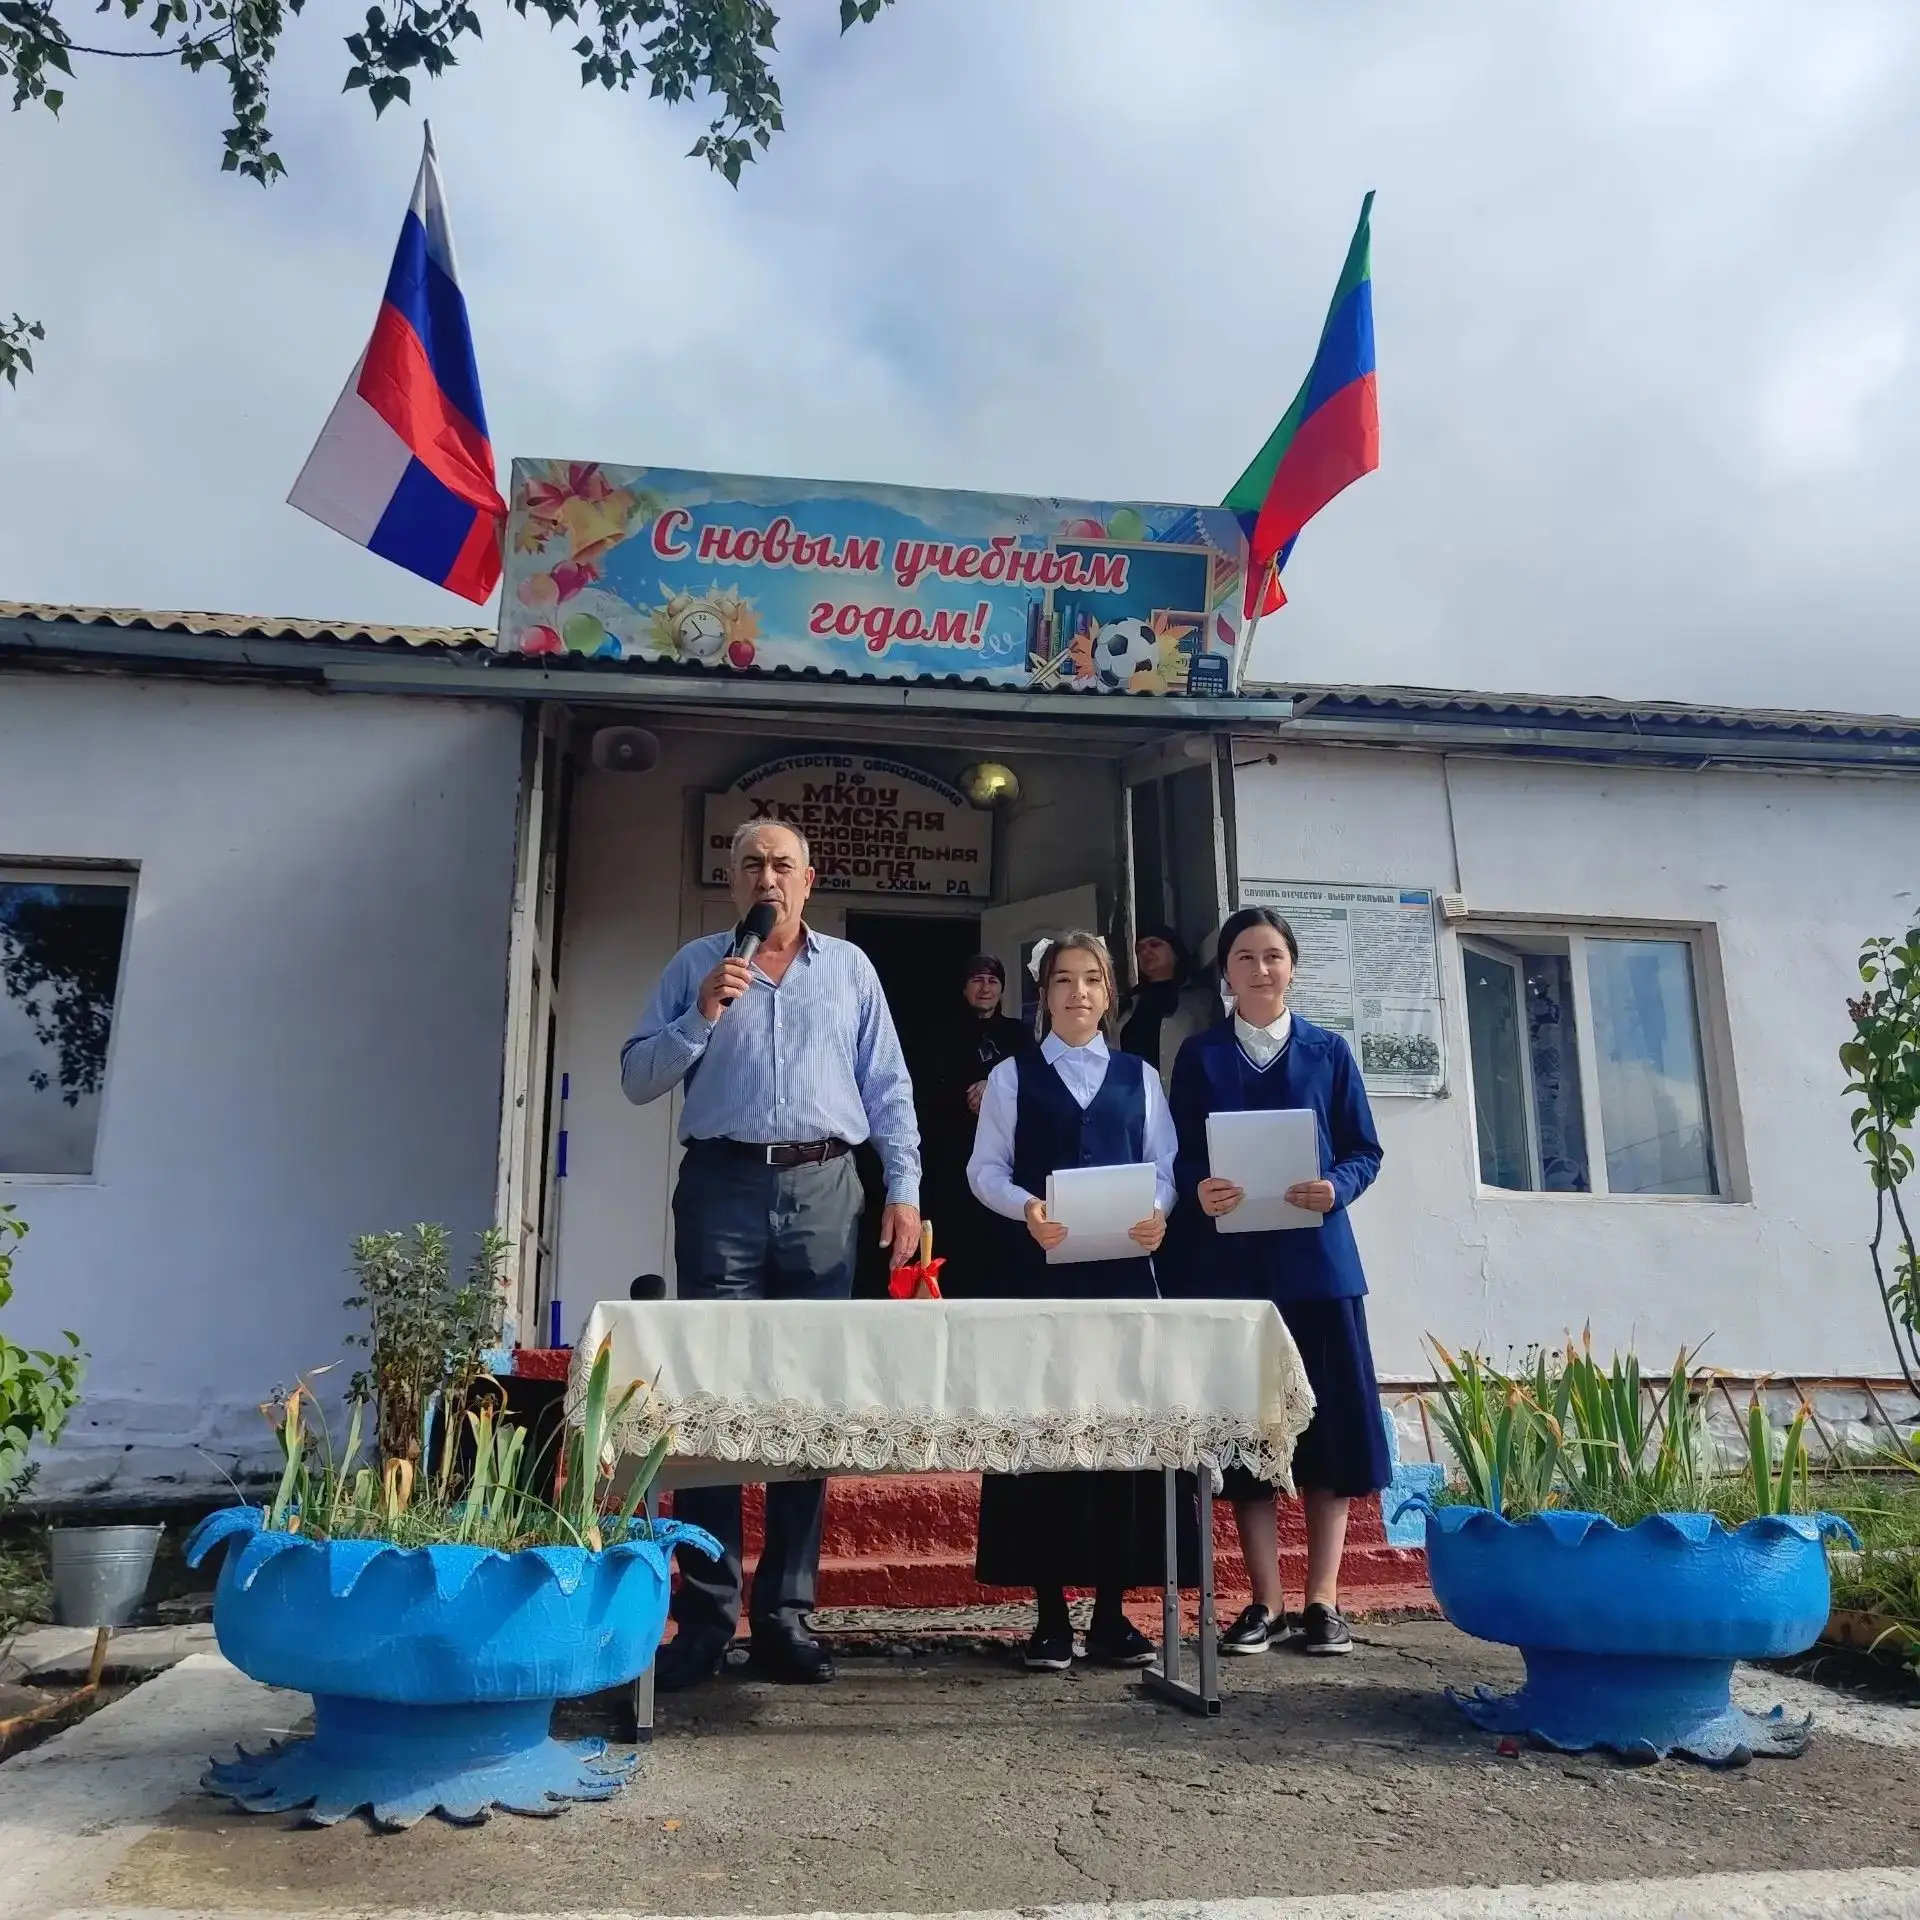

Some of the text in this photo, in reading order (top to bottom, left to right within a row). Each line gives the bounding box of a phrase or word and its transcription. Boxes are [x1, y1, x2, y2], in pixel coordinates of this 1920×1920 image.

[653, 510, 1125, 588] С новым учебным
[809, 602, 989, 652] годом!
[736, 755, 964, 808] МИНИСТЕРСТВО ОБРАЗОВАНИЯ
[802, 782, 900, 807] МКОУ
[750, 797, 946, 832] ХКЕМСКАЯ
[946, 877, 972, 894] РД
[1244, 888, 1281, 898] СЛУЖИТЬ
[1281, 890, 1323, 900] ОТЕЧЕСТВУ
[1327, 892, 1356, 901] ВЫБОР
[1356, 893, 1395, 903] СИЛЬНЫХ
